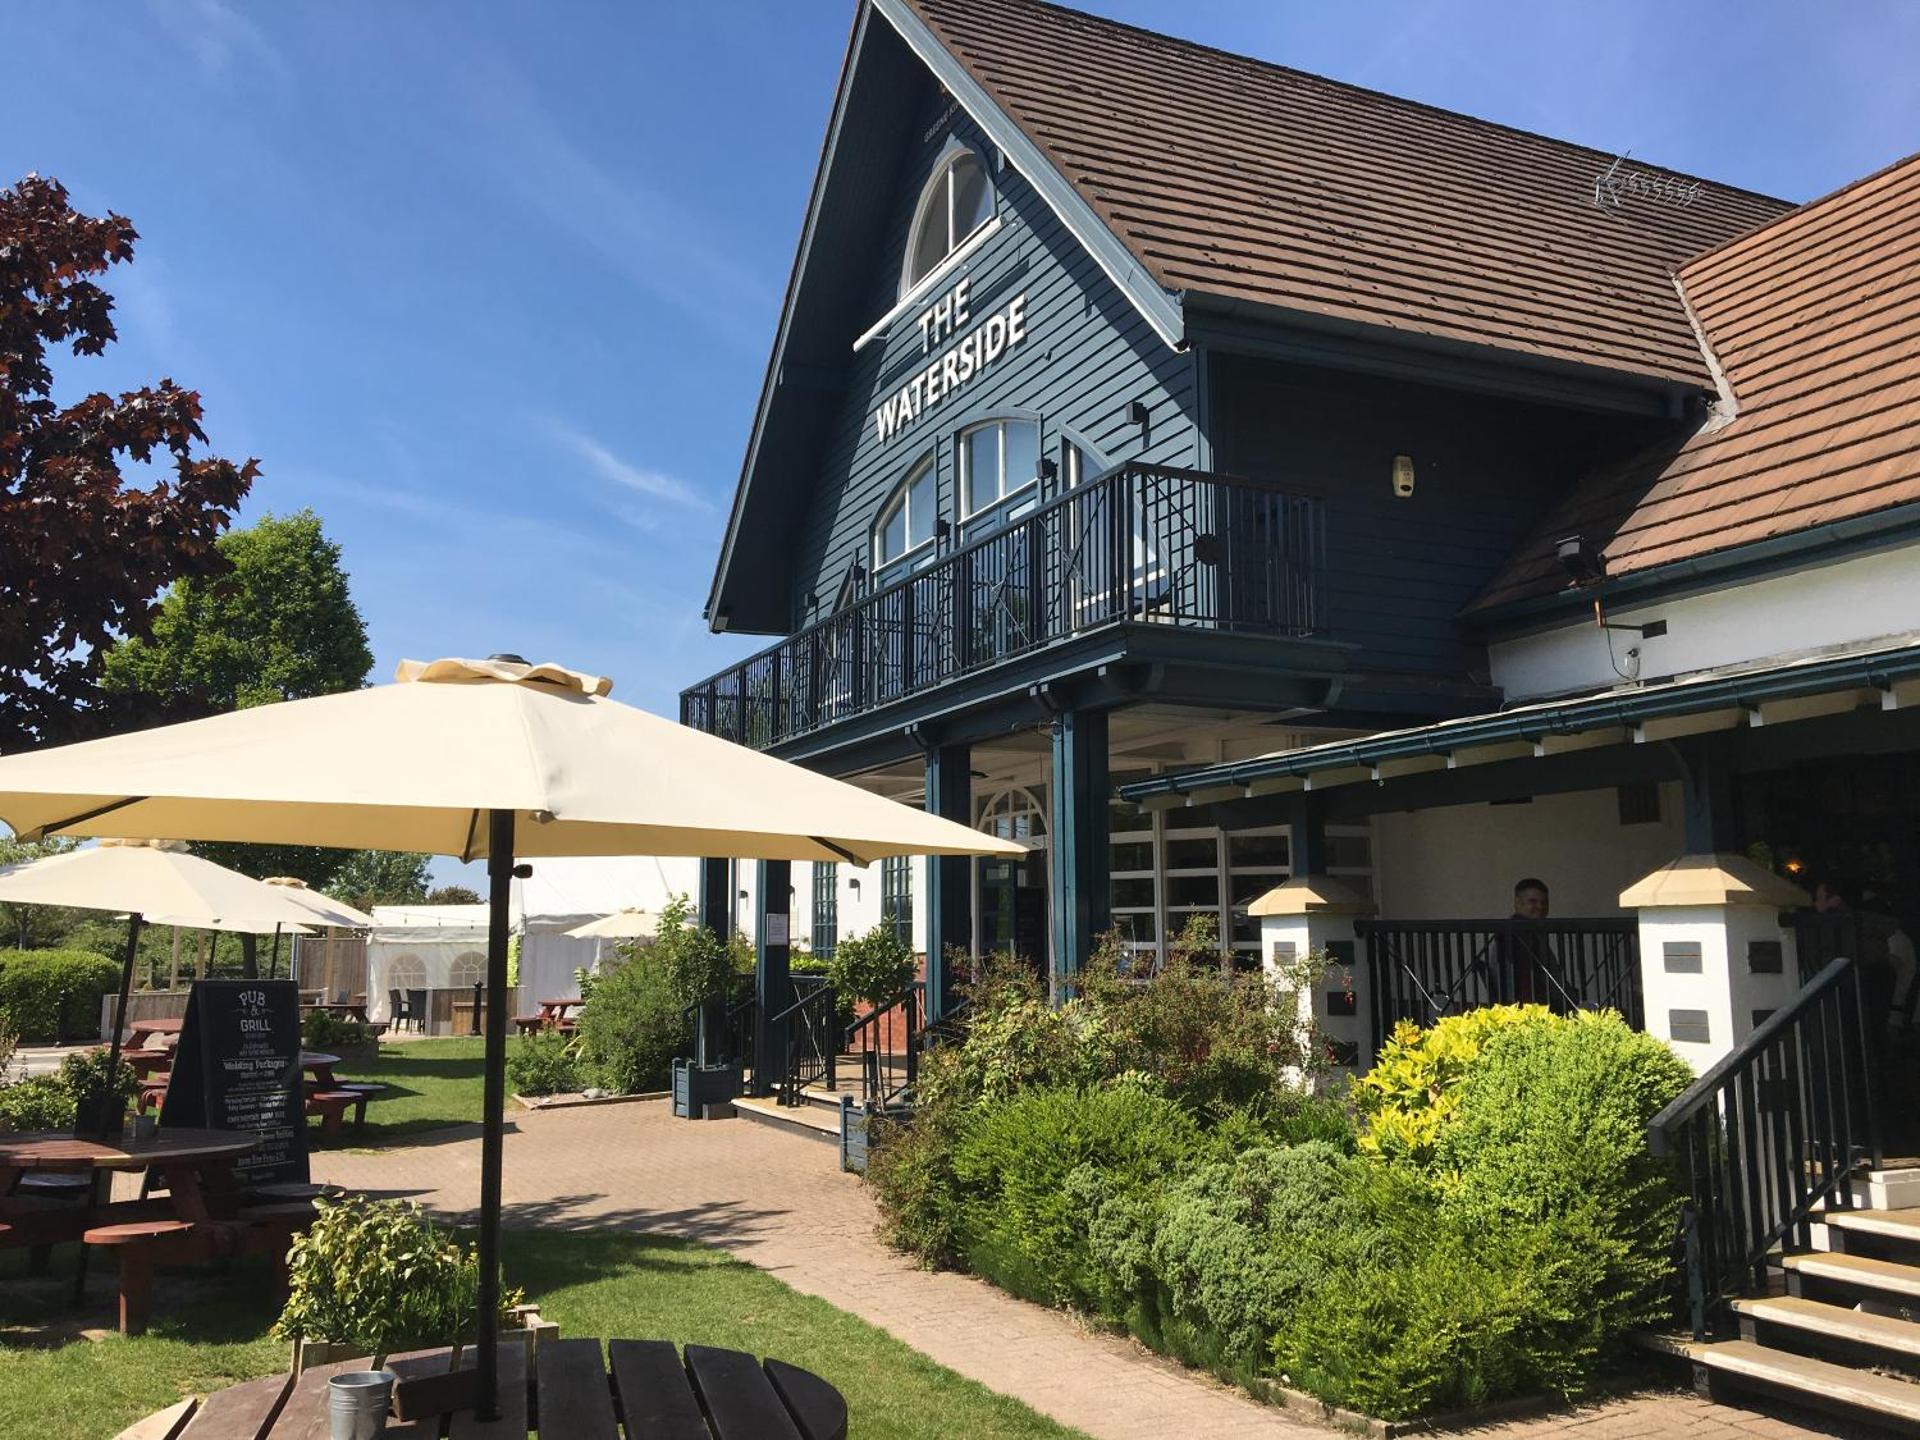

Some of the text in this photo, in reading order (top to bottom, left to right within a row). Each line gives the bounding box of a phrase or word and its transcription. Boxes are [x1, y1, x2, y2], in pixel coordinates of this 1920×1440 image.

[917, 277, 971, 354] THE
[876, 293, 1027, 442] WATERSIDE
[238, 990, 266, 1006] PUB
[250, 1004, 260, 1016] &
[240, 1019, 272, 1032] GRILL
